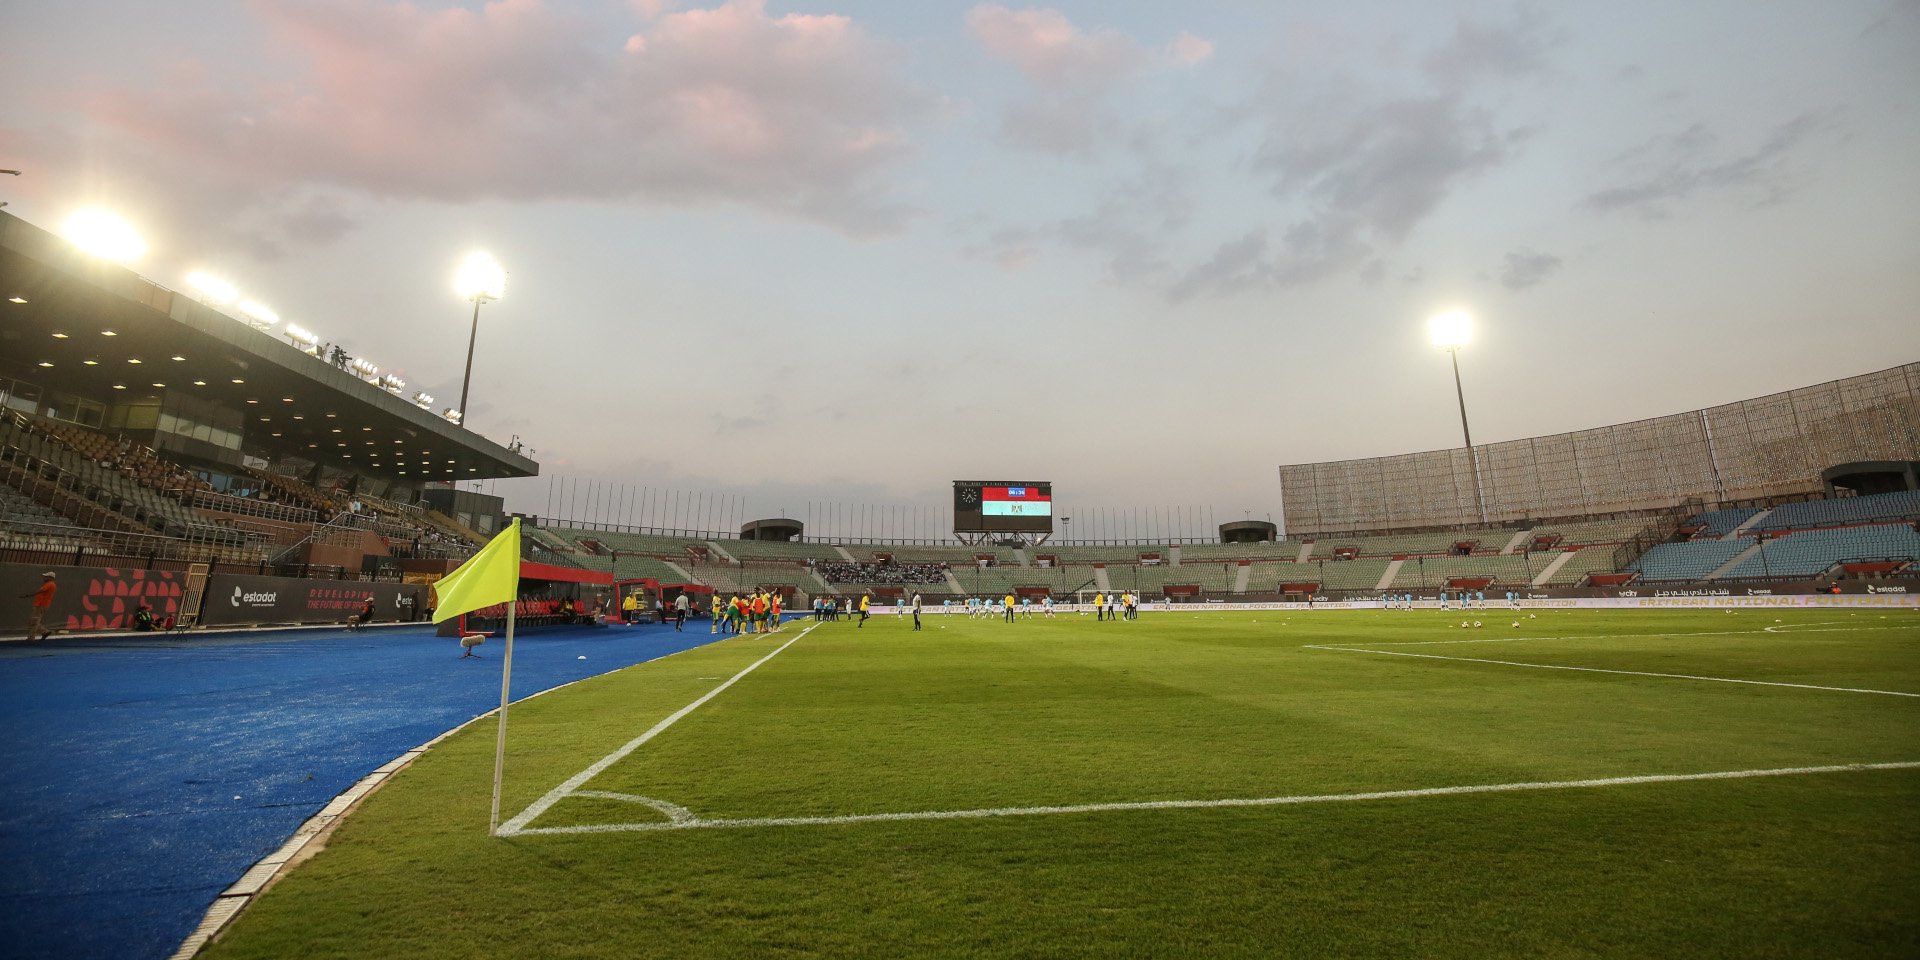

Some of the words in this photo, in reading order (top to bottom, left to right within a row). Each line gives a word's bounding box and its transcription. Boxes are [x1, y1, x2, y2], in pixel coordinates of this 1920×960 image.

[244, 591, 277, 602] estadat
[310, 588, 374, 599] DEVELOPING
[307, 600, 320, 609] THE
[320, 600, 344, 609] FUTURE
[1715, 597, 1801, 606] NATIONAL
